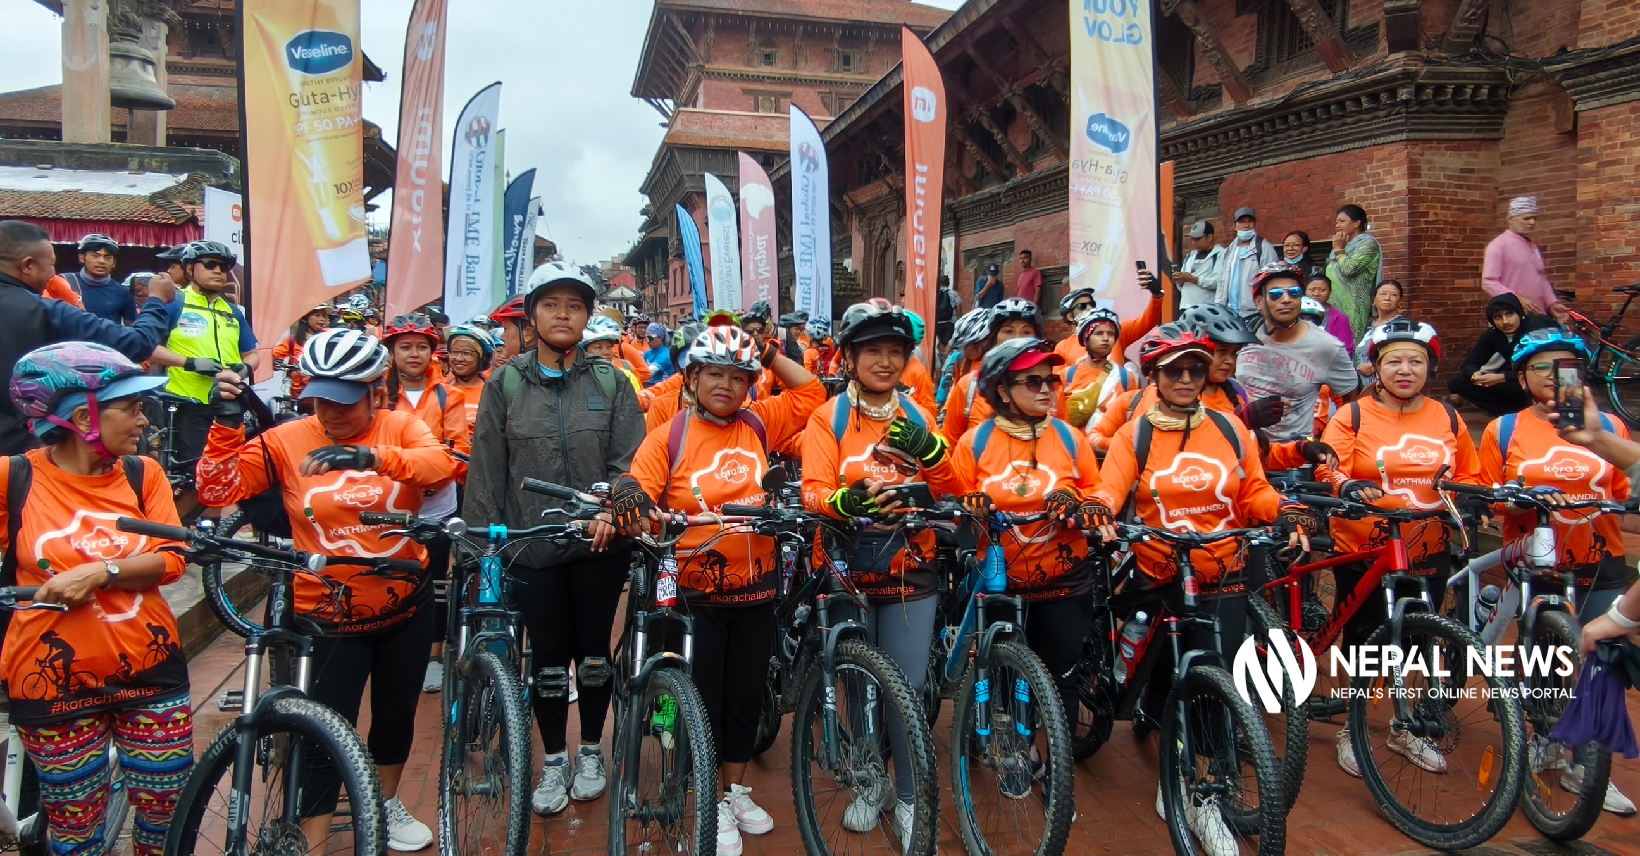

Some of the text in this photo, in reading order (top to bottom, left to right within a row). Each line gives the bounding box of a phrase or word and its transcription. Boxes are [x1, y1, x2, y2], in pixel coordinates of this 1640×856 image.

[313, 118, 333, 132] 50
[465, 254, 481, 297] Bank
[714, 467, 738, 481] kora
[863, 462, 889, 474] kora
[1543, 464, 1574, 473] kora
[1171, 473, 1200, 484] kora
[334, 490, 367, 502] kora
[1168, 503, 1226, 518] KATHMANDU
[70, 536, 110, 550] kora
[710, 588, 777, 604] #korachallenge
[51, 685, 163, 714] #korachallenge
